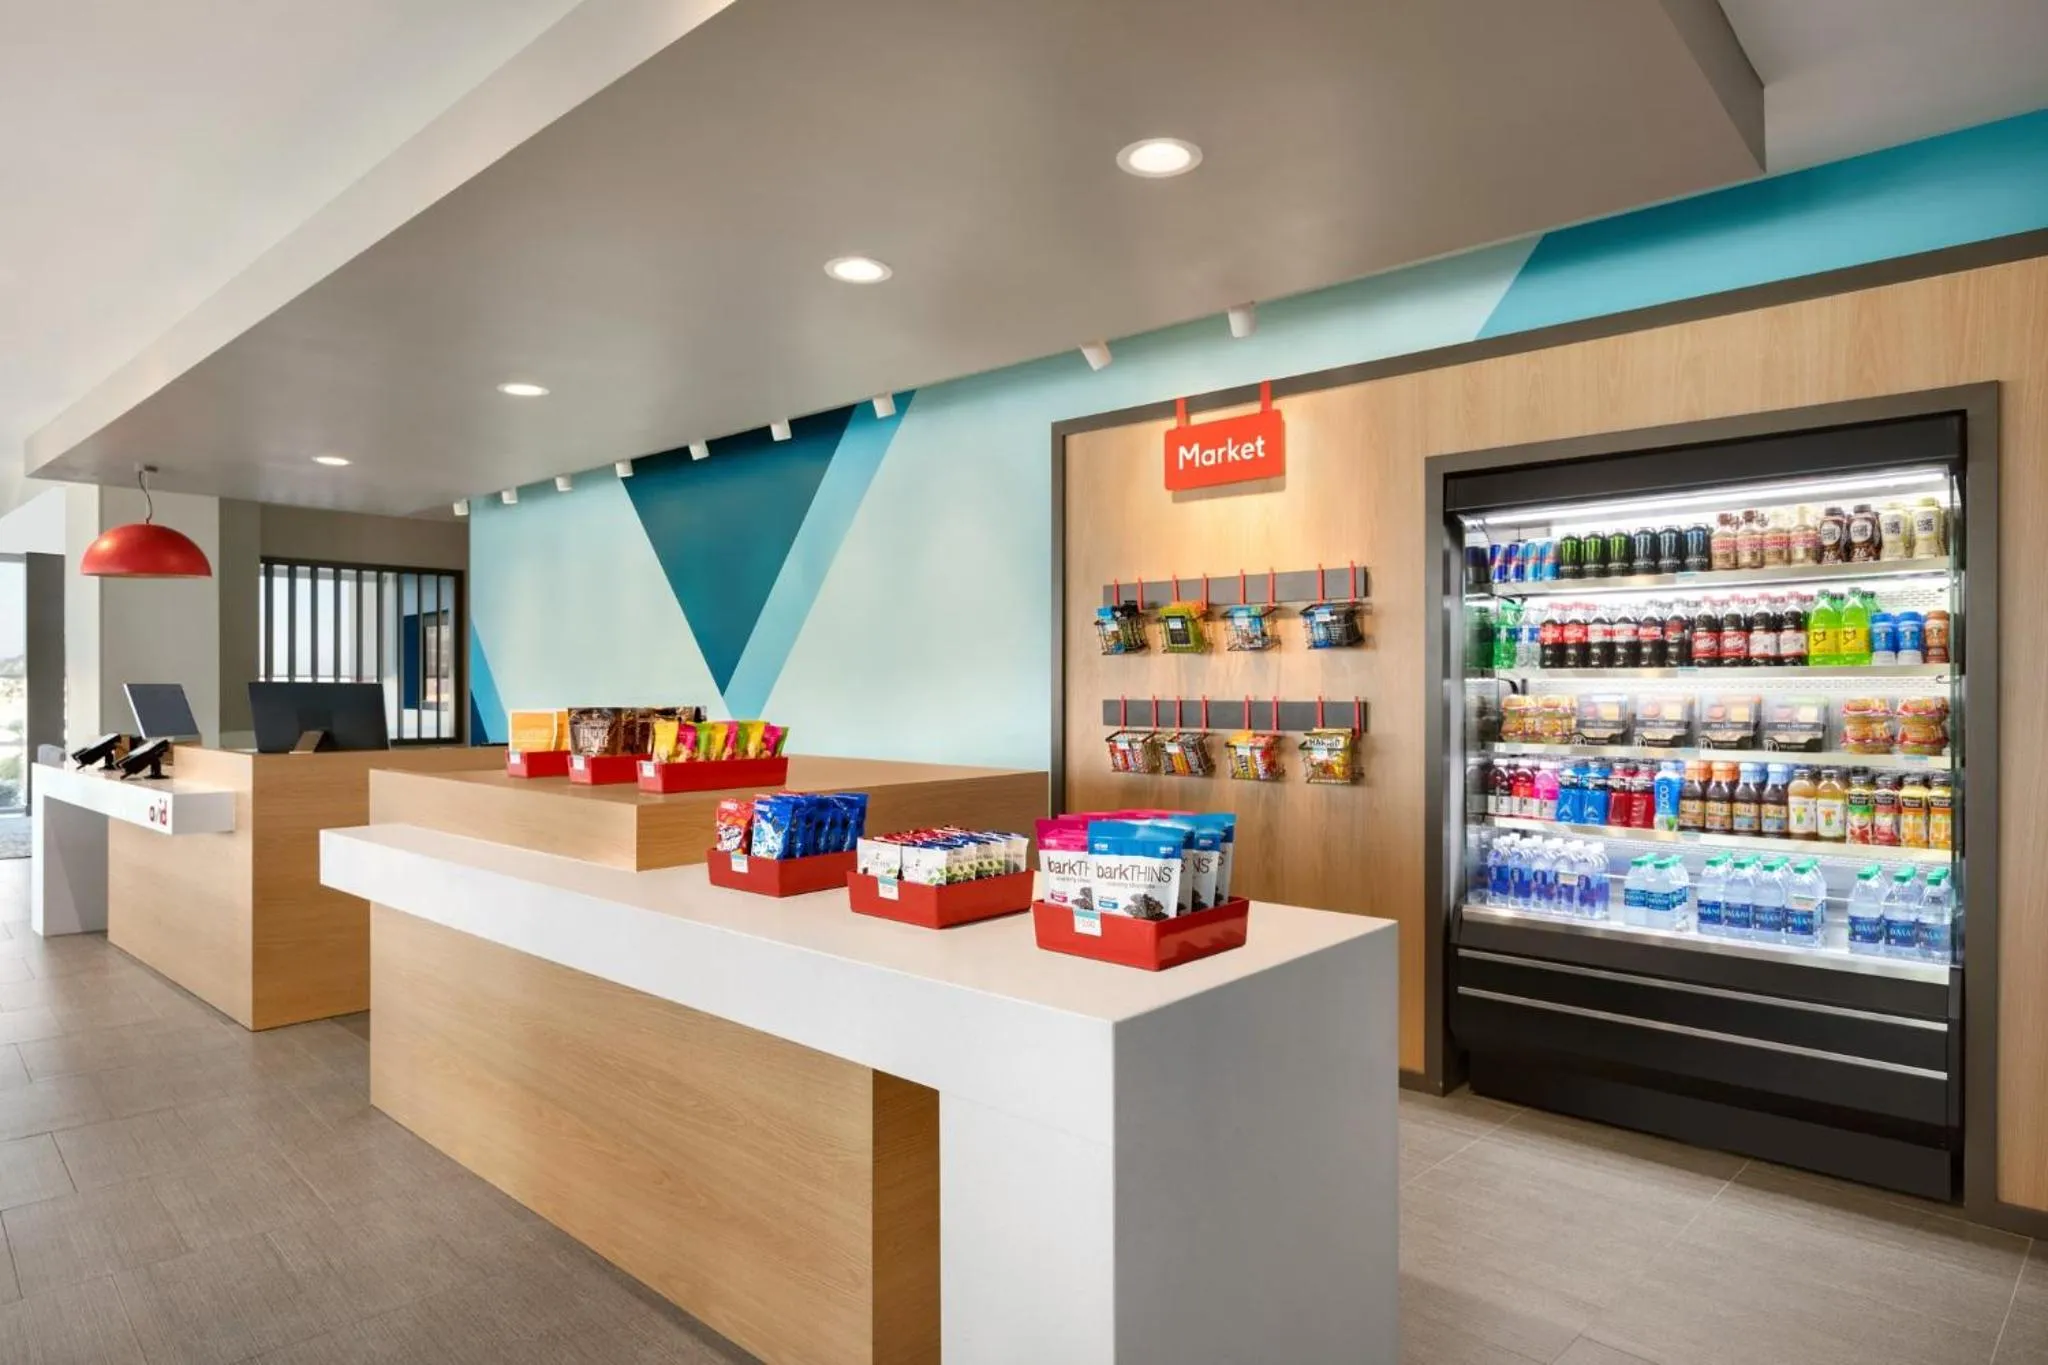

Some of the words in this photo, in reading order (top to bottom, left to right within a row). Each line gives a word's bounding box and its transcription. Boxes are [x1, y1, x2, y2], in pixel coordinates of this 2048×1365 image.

[1178, 435, 1265, 470] Market
[1047, 856, 1090, 876] barkT
[1096, 862, 1170, 883] barkTHINS
